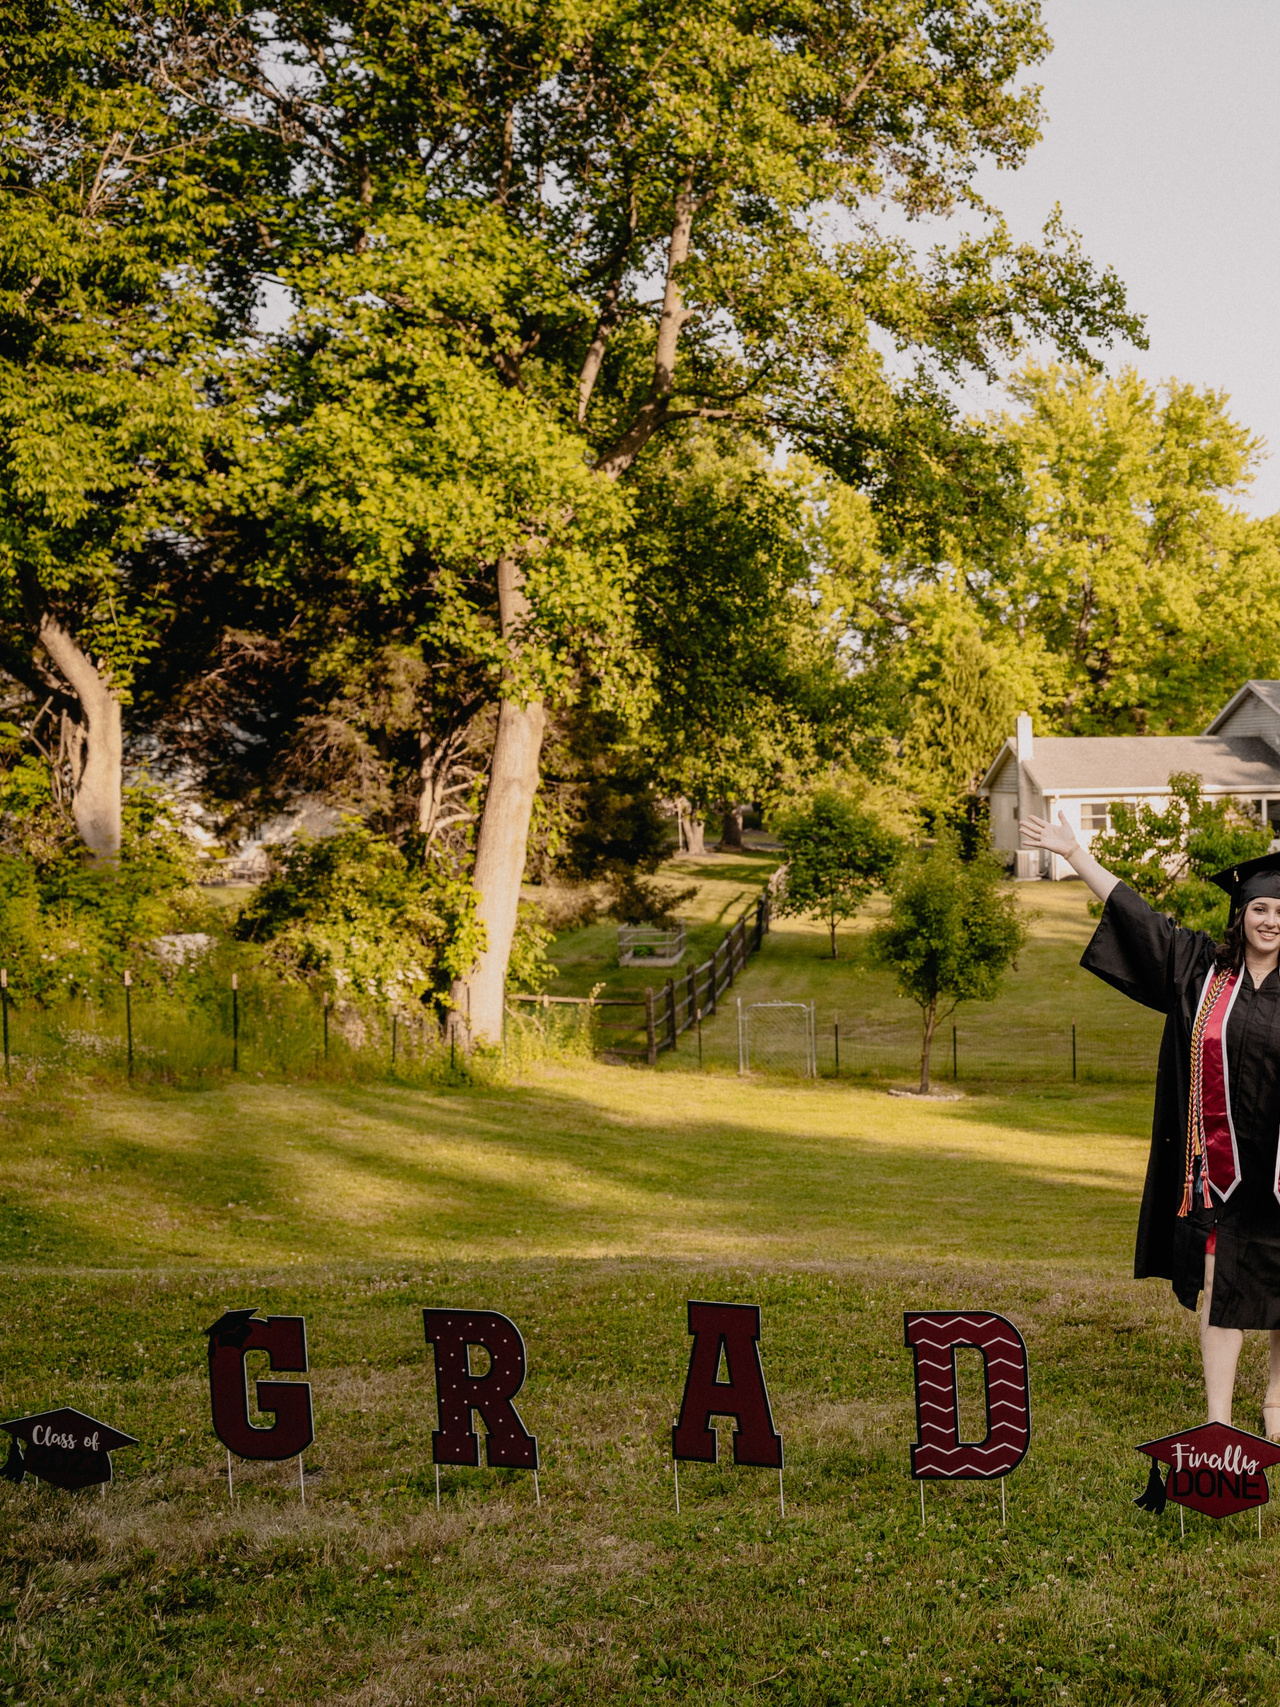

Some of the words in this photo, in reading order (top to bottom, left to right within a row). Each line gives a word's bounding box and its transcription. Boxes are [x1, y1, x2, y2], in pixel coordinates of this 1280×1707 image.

[32, 1424, 77, 1449] Class
[83, 1431, 100, 1451] of
[1172, 1443, 1259, 1475] Finally
[1173, 1470, 1261, 1499] DONE
